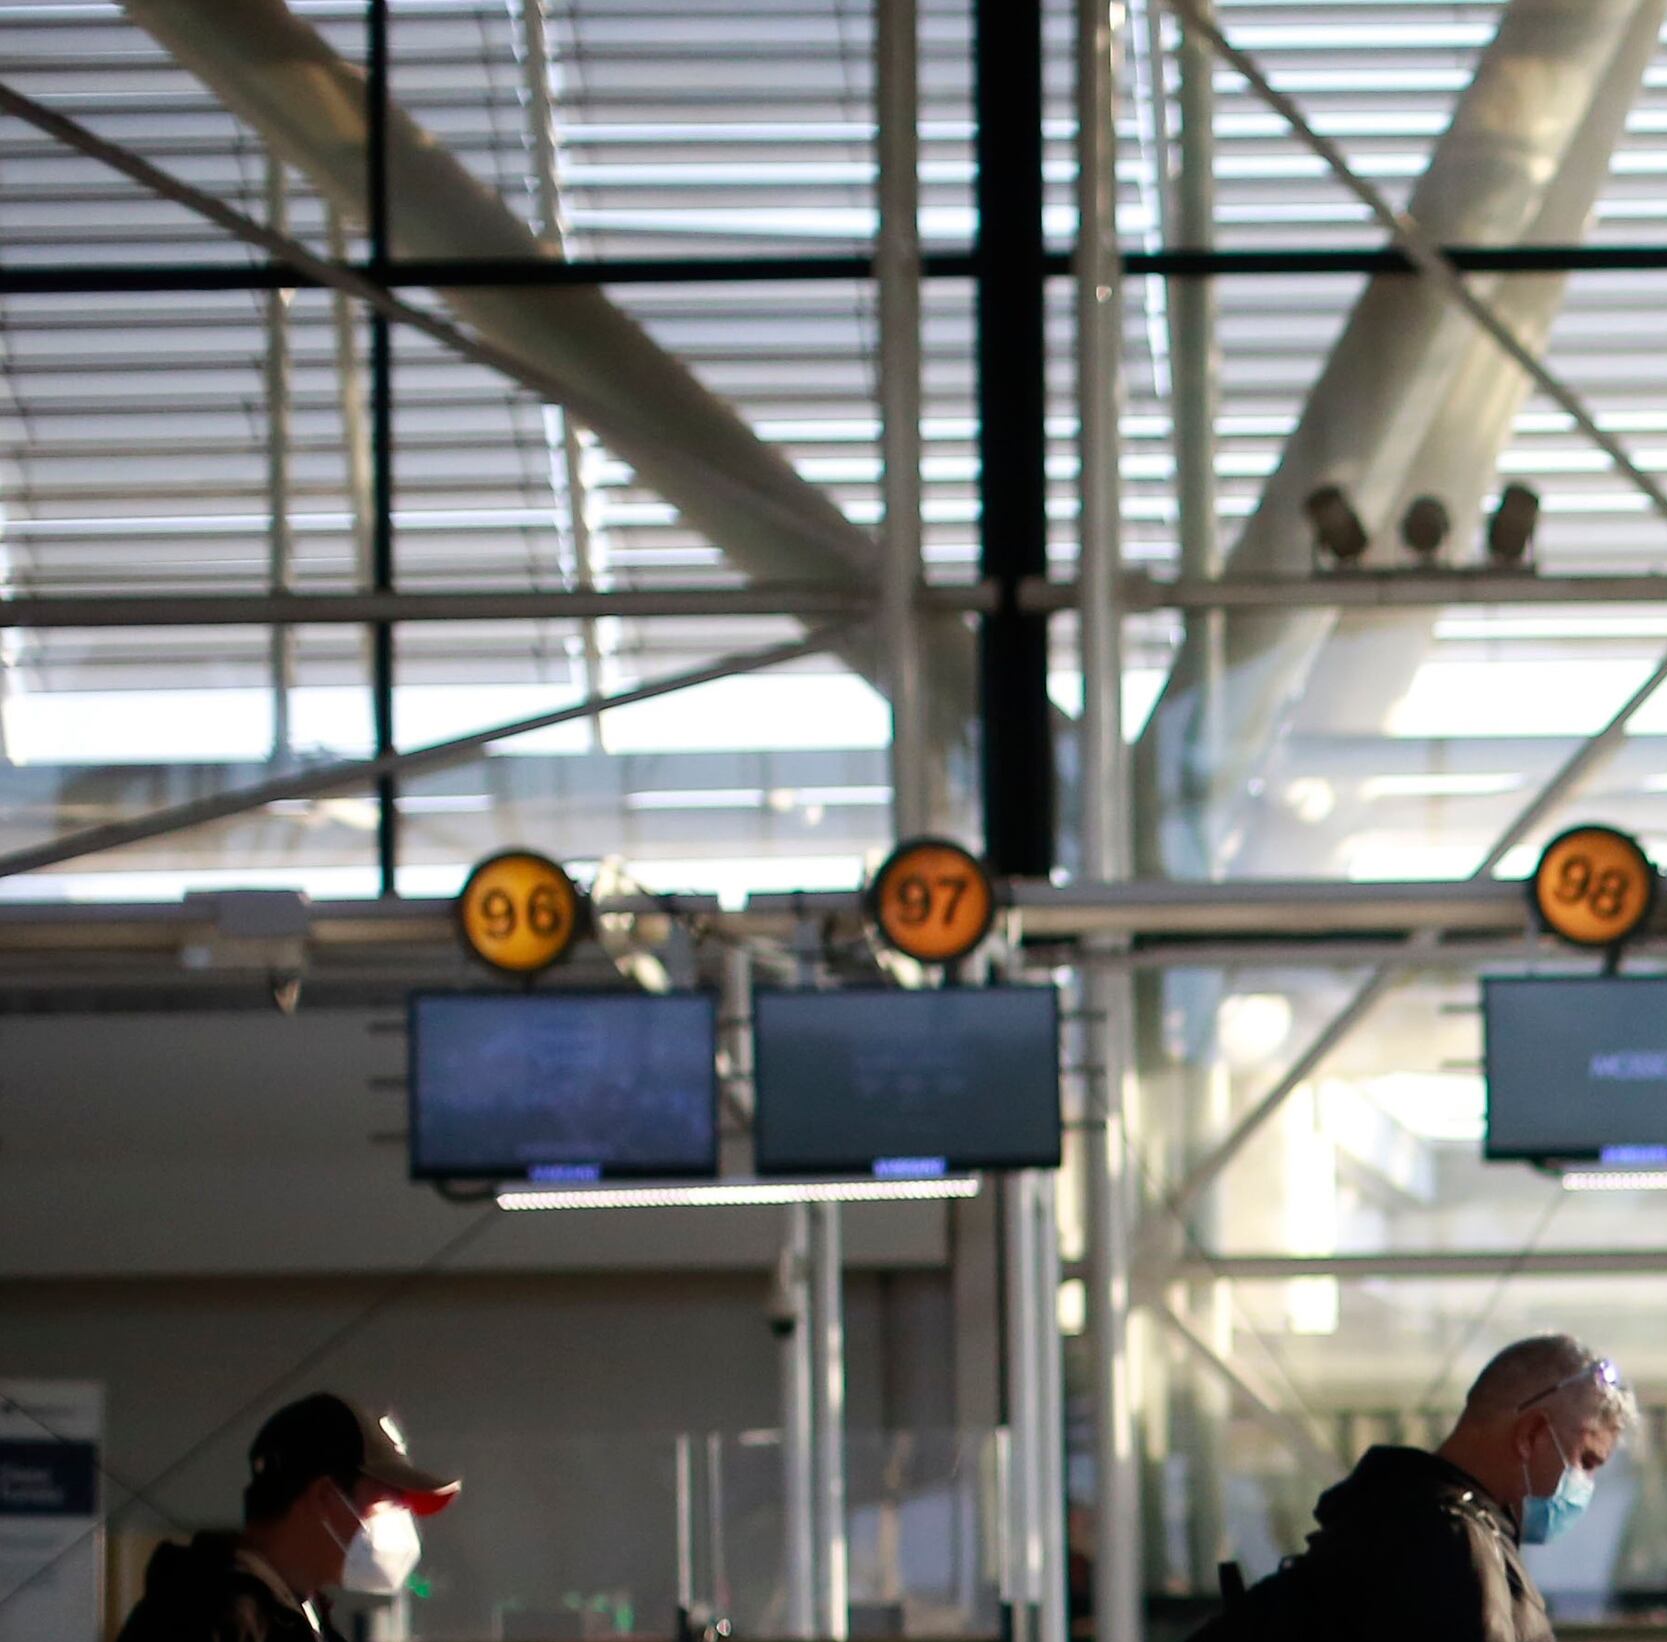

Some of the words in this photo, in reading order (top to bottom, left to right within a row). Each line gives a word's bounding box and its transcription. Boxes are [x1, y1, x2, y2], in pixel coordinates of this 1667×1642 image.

[479, 884, 565, 940] 96
[896, 872, 970, 926] 97
[1552, 853, 1631, 919] 98
